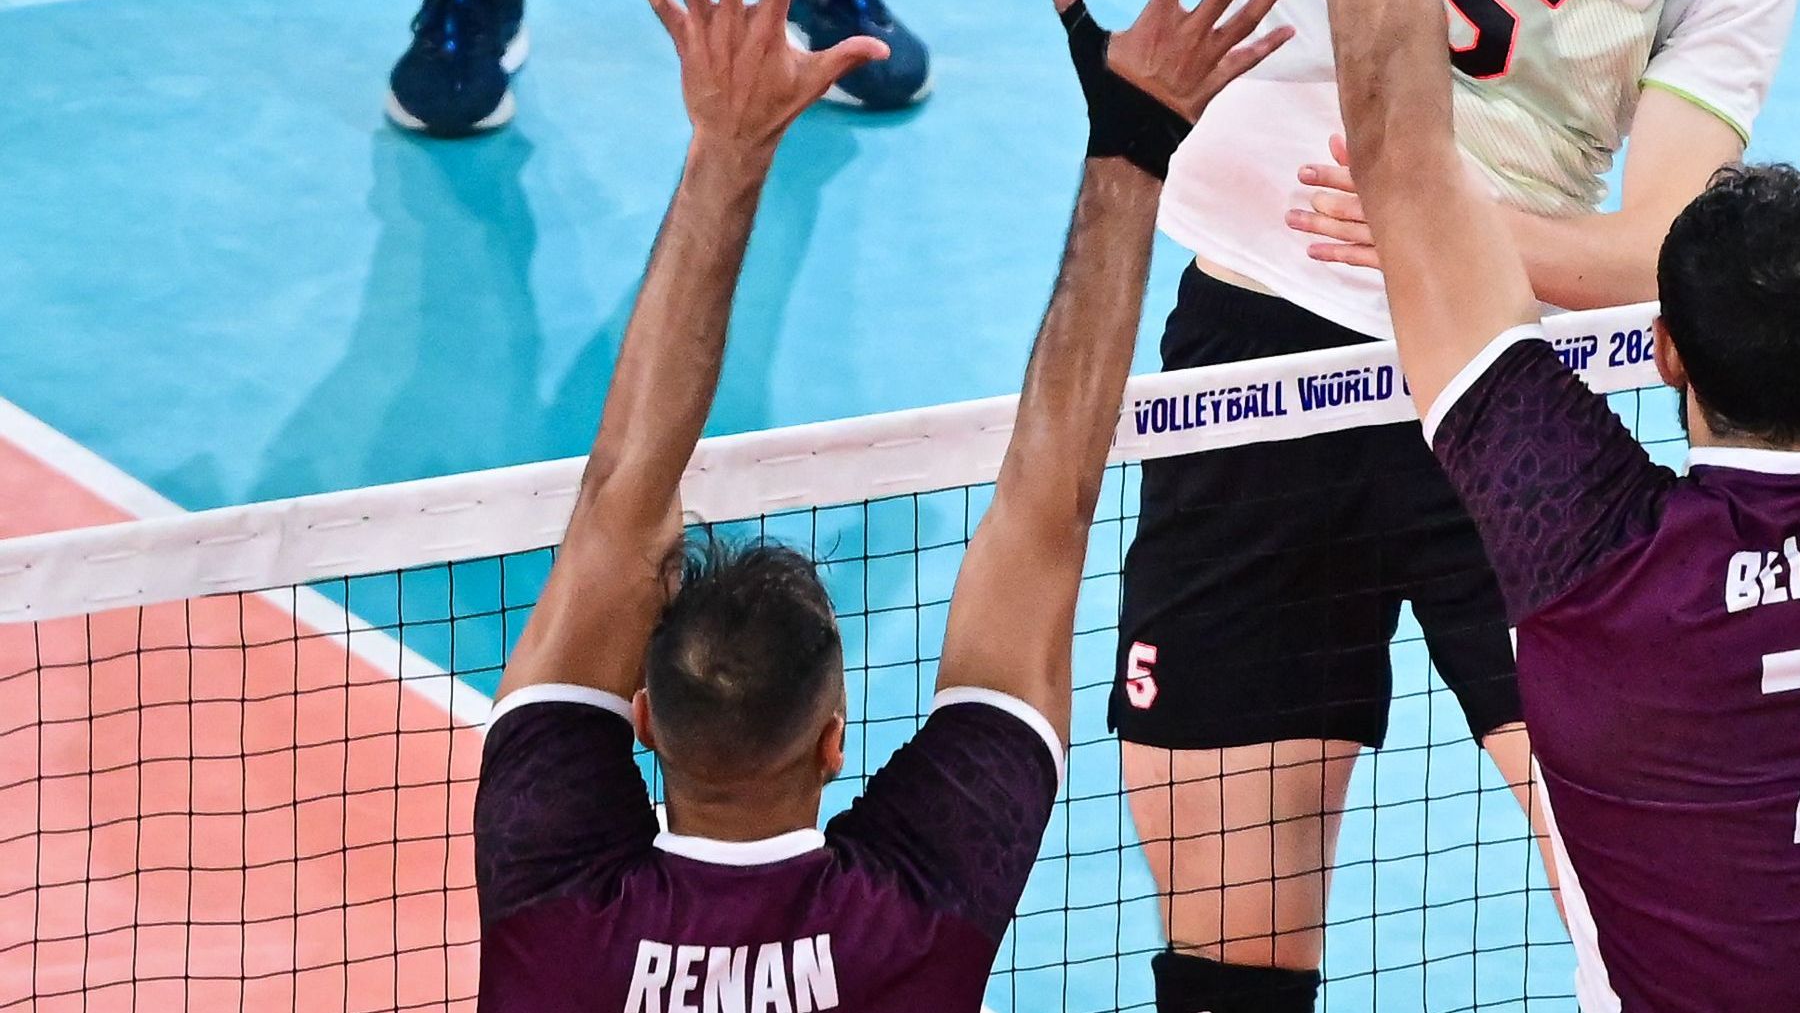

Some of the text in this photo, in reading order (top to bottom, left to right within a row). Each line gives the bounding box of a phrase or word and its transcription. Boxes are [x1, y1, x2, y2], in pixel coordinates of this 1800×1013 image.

[1134, 380, 1288, 436] VOLLEYBALL
[1297, 365, 1394, 412] WORLD
[1125, 640, 1159, 710] 5
[623, 933, 840, 1013] RENAN
